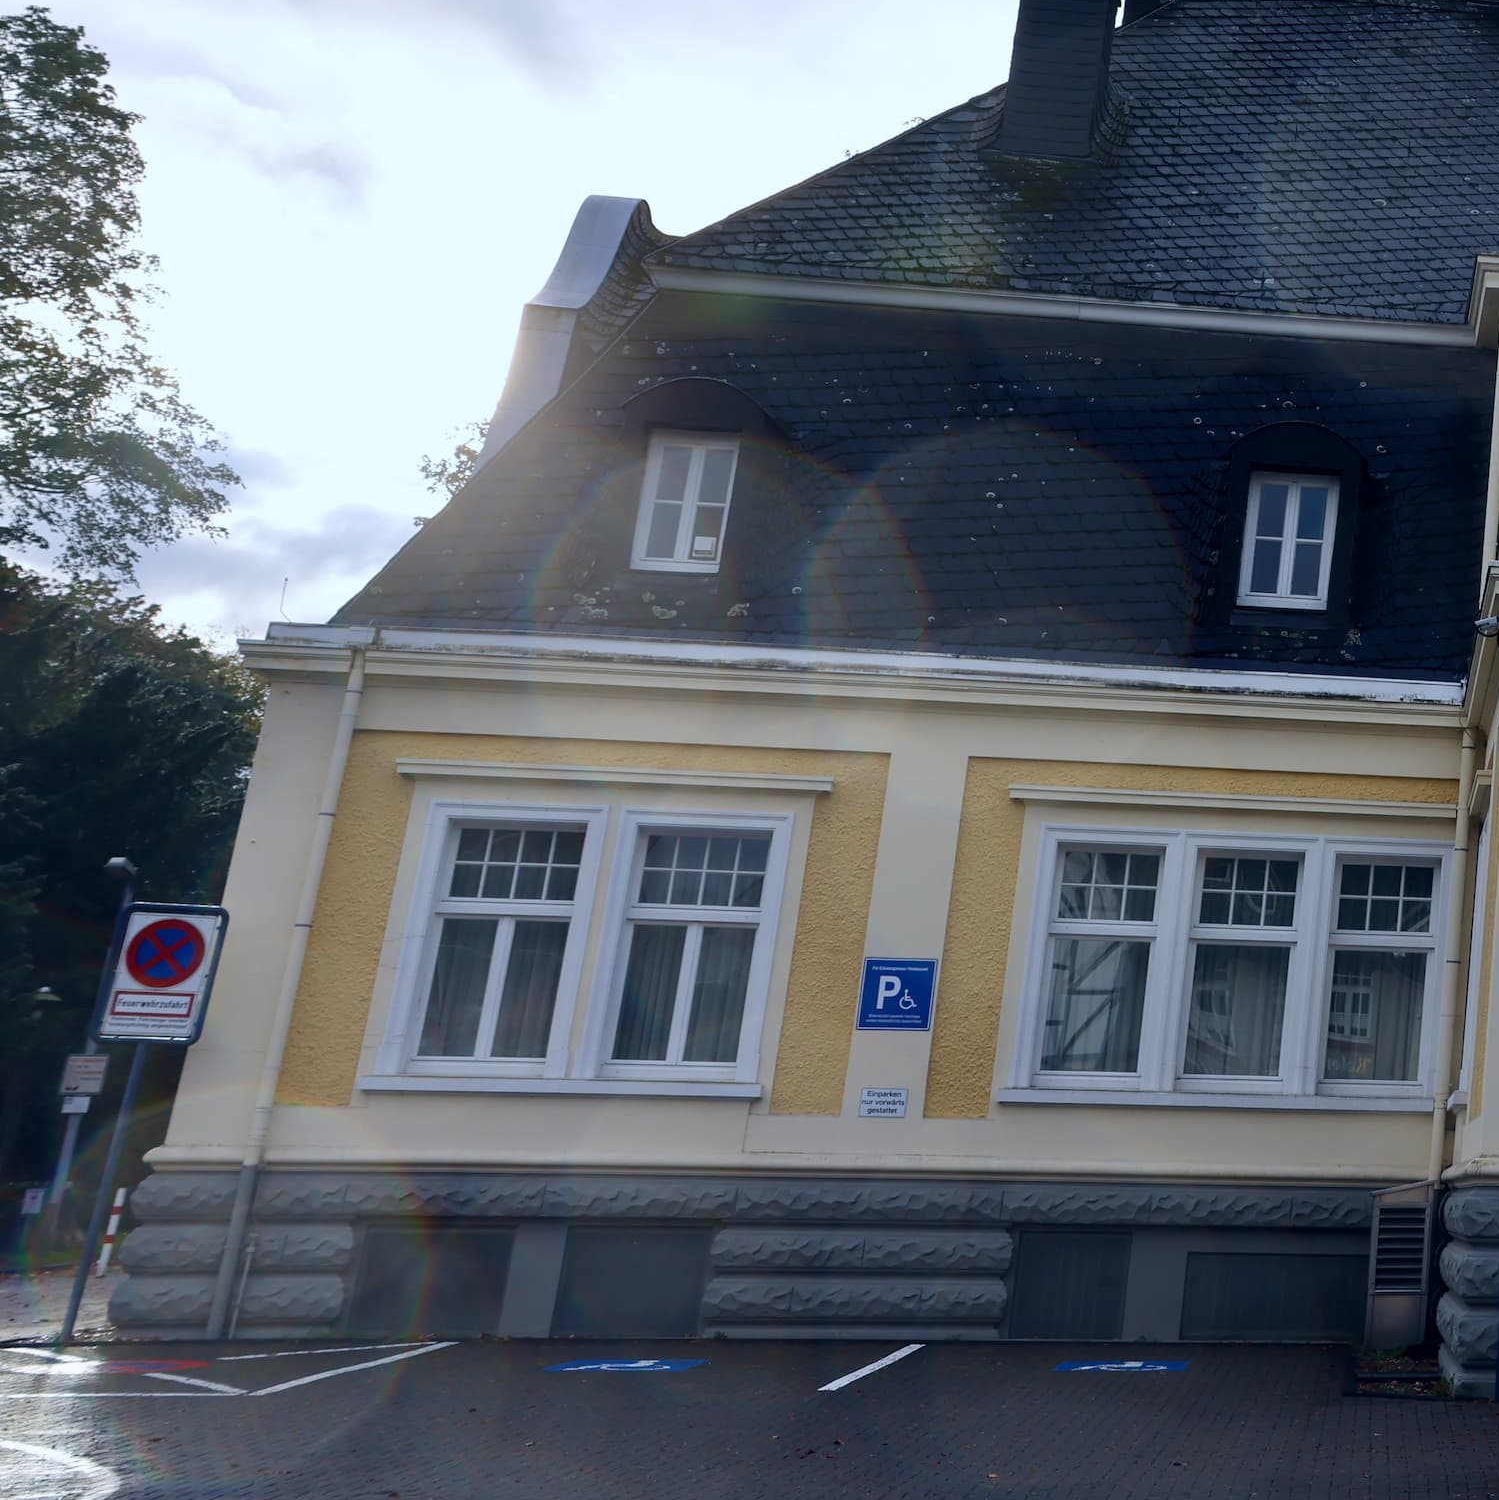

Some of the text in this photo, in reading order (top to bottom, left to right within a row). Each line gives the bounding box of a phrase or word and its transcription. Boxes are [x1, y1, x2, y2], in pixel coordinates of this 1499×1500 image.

[876, 975, 902, 1009] P
[117, 998, 189, 1010] Feuerwehrzufahrt
[867, 1090, 902, 1099] Einparken
[867, 1107, 898, 1115] gestattet
